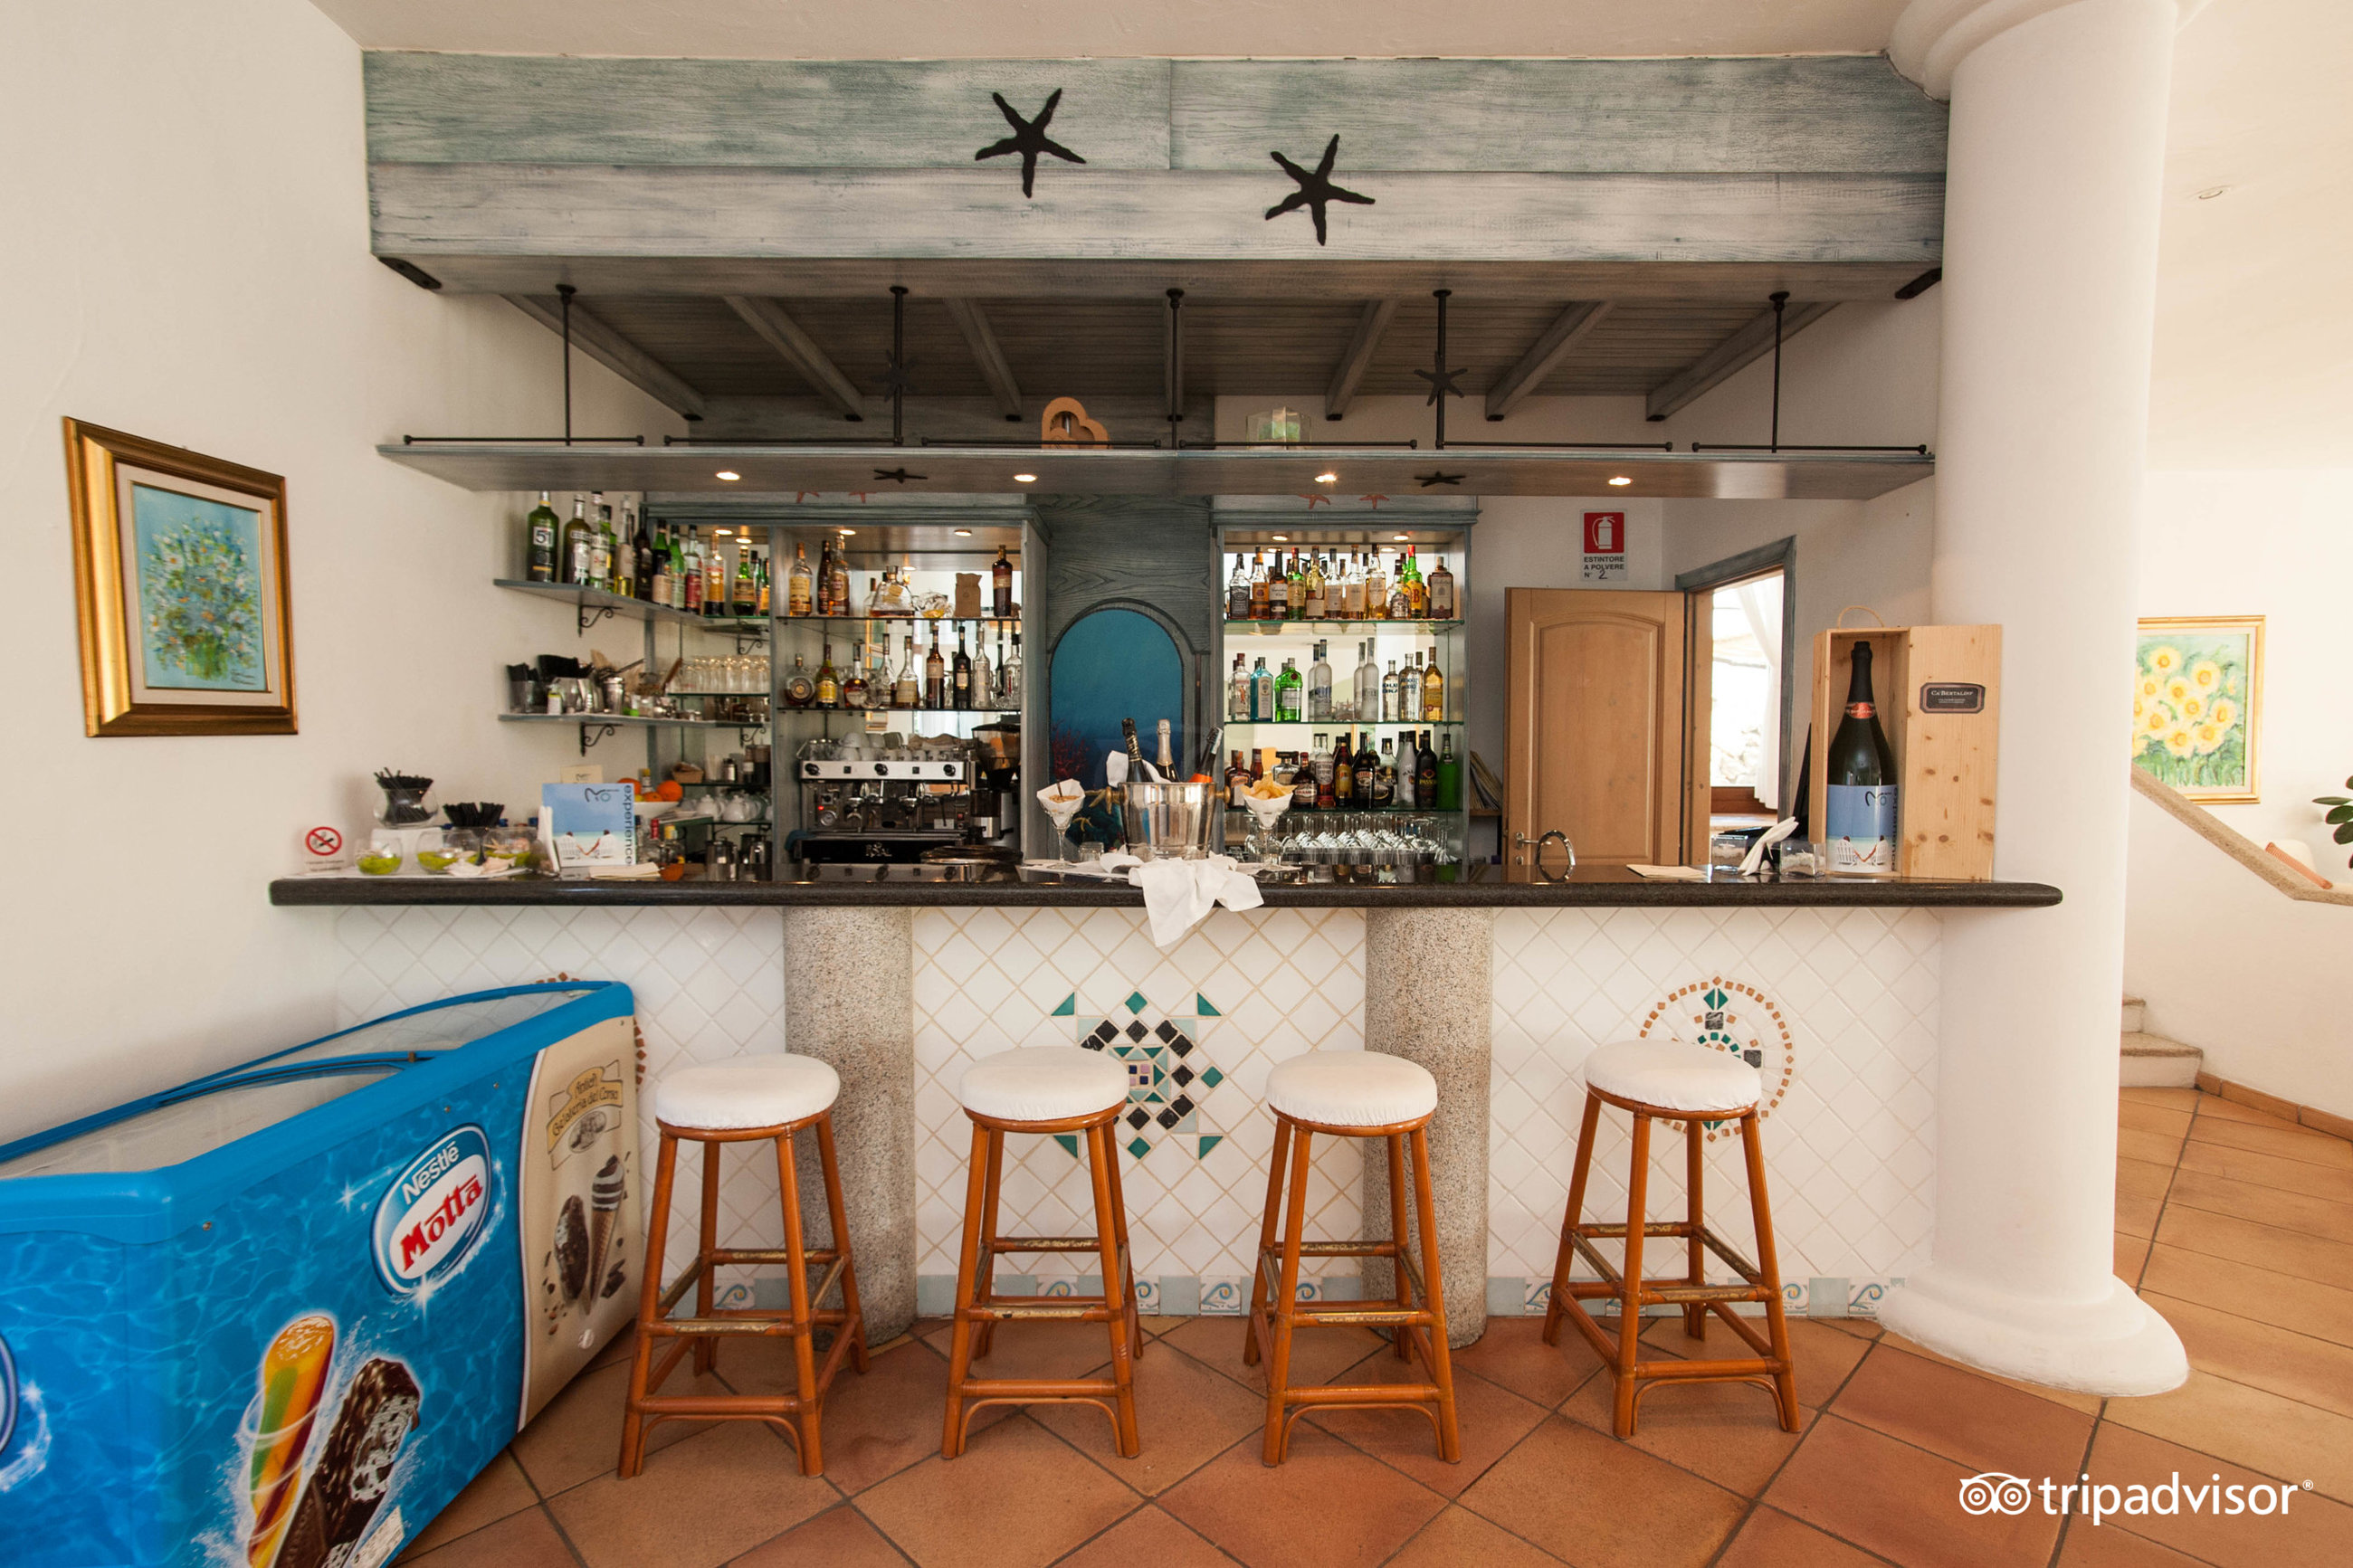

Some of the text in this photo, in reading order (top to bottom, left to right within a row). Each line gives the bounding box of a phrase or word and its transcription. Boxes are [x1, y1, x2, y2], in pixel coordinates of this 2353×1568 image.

[623, 784, 633, 866] experience
[552, 1098, 587, 1136] Gelateria
[402, 1140, 460, 1206] Nestlé
[400, 1174, 484, 1273] Motta
